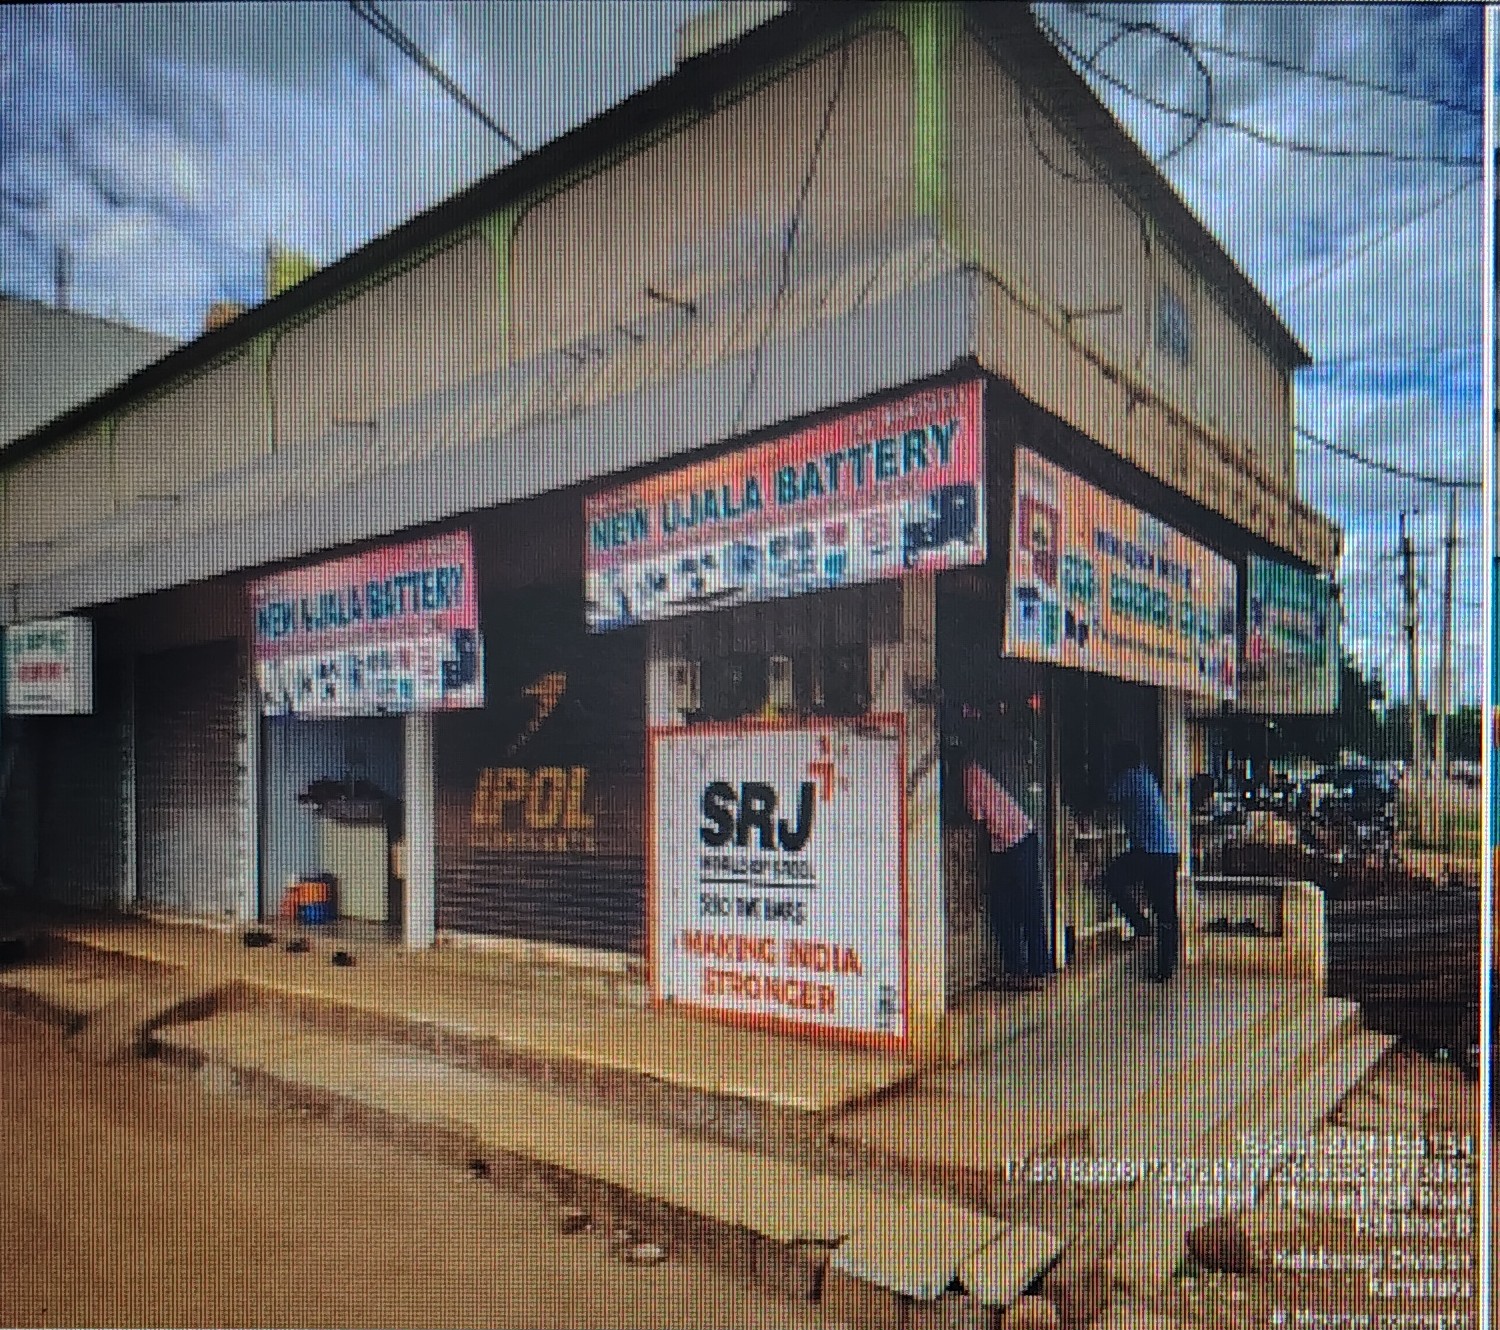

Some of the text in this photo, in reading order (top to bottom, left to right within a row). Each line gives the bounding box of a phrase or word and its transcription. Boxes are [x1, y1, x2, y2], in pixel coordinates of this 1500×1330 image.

[589, 508, 649, 552] NEW
[661, 475, 763, 533] UJALA
[775, 420, 960, 506] BATTERY
[366, 565, 464, 620] BATTERY
[700, 779, 816, 853] SRJ
[682, 929, 863, 977] MAKING INDIA
[702, 967, 837, 1014] STRONGER
